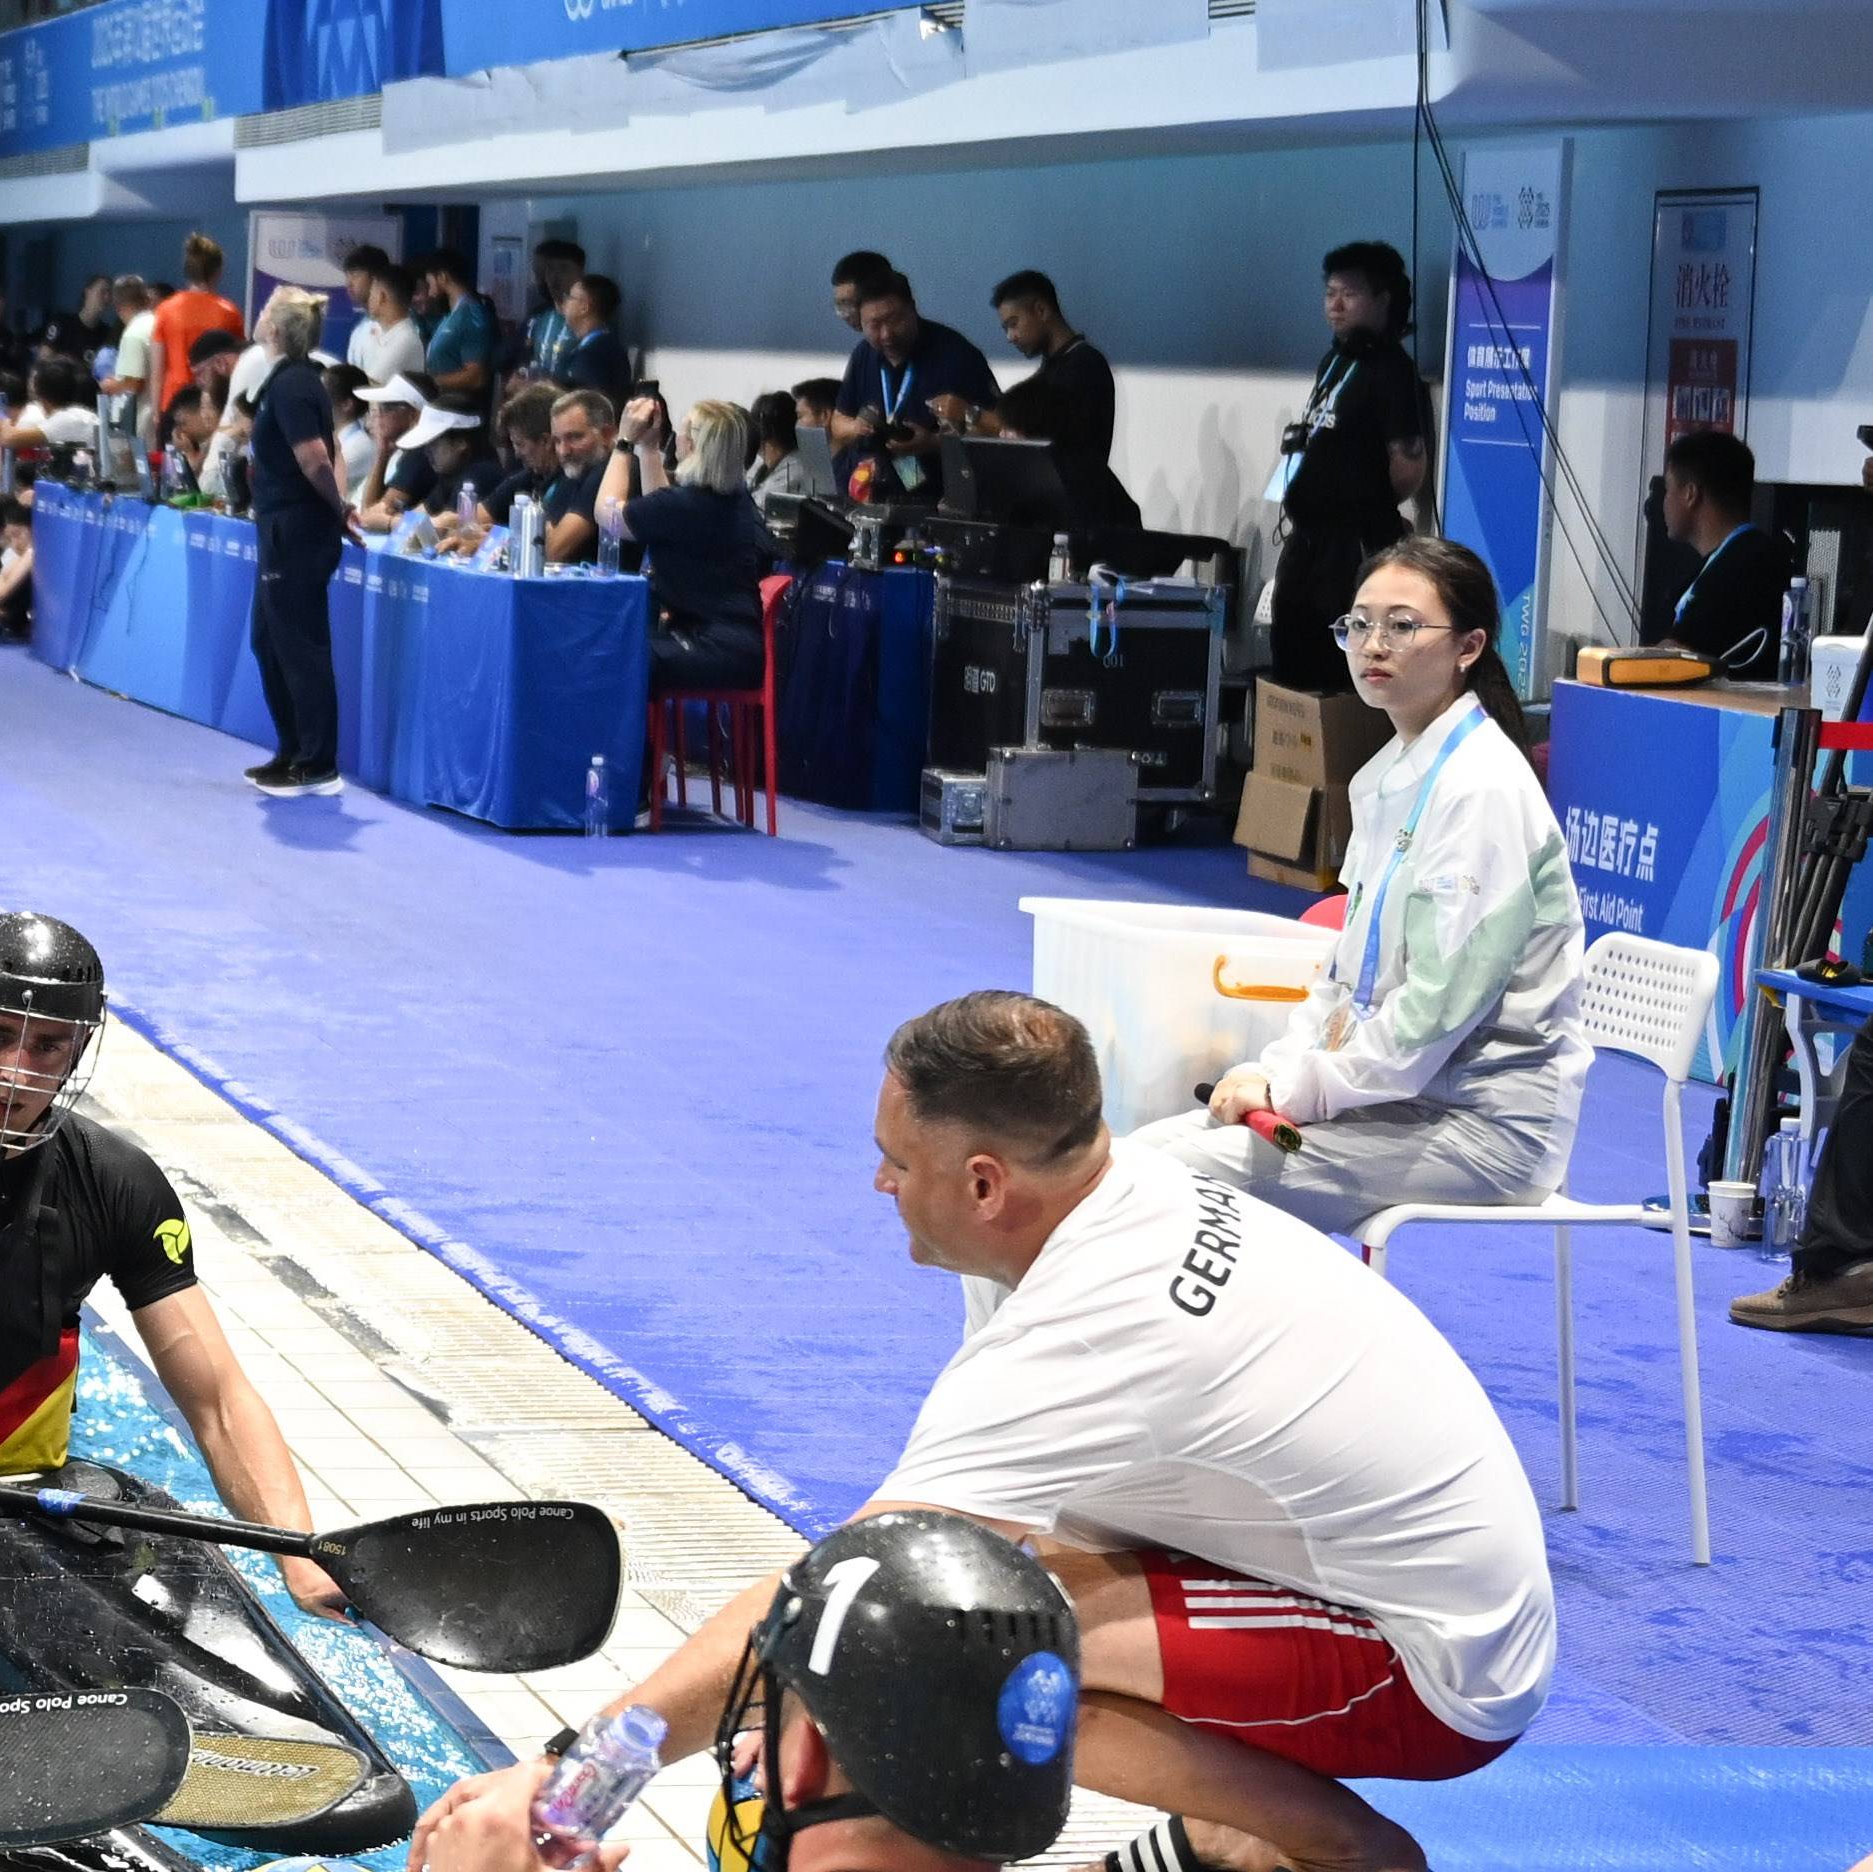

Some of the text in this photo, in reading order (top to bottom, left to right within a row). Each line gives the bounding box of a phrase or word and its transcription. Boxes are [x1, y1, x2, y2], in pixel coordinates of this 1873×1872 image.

[1676, 263, 1730, 309] 消火栓
[1565, 805, 1659, 883] 场边医疗点
[1599, 891, 1615, 924] Aid
[1616, 896, 1644, 933] Point
[411, 1505, 575, 1529] Canoe Polo Sports in my life
[317, 1540, 346, 1556] 15081
[808, 1555, 882, 1677] 1
[35, 1695, 72, 1710] Polo
[77, 1692, 128, 1707] Canoe
